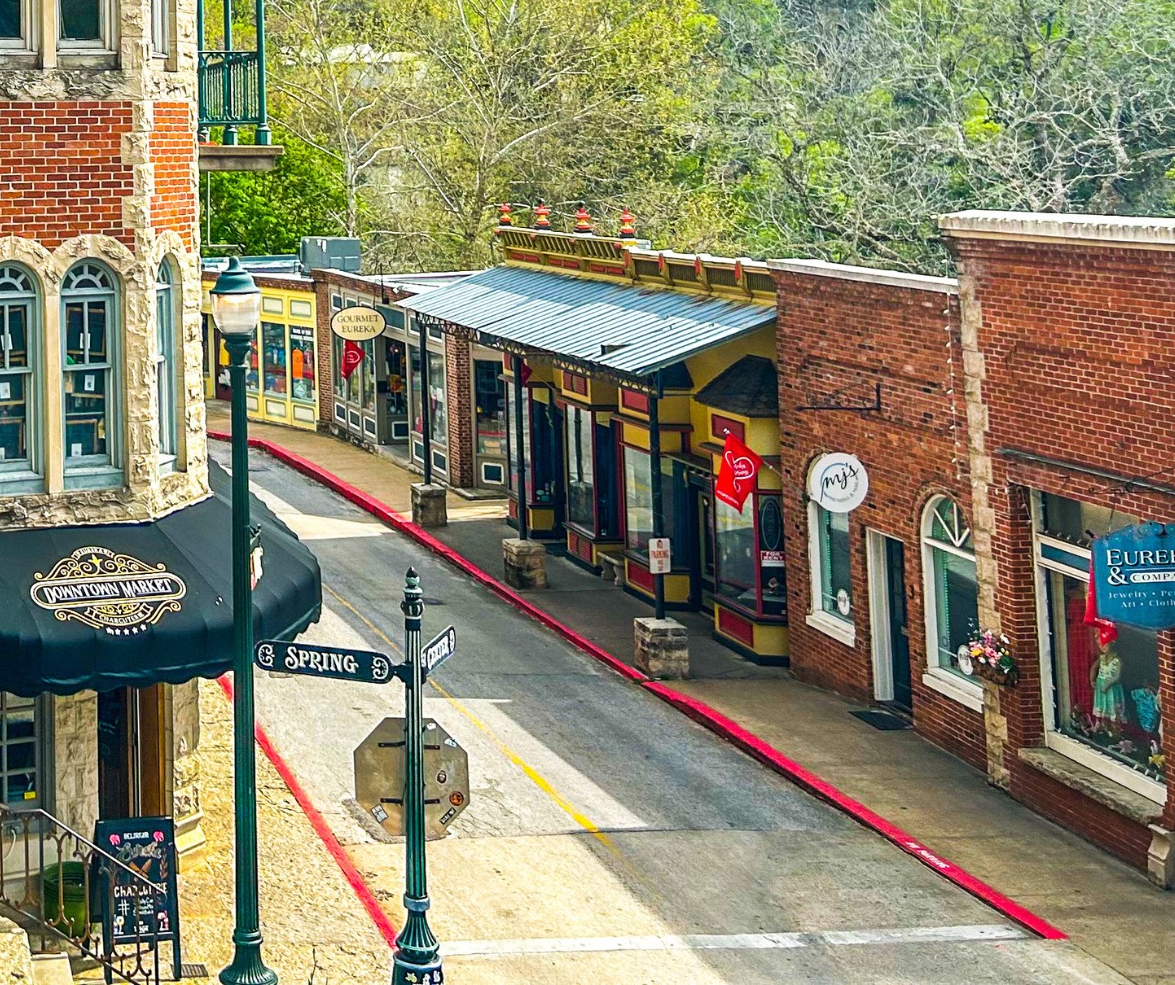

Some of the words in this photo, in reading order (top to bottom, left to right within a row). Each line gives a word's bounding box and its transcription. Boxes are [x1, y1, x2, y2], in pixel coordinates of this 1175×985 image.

[336, 314, 379, 324] GOURMET
[341, 324, 377, 333] EUREKA
[1107, 566, 1129, 586] &
[42, 581, 120, 604] DOWNTOWN
[120, 577, 173, 598] MARKET
[1108, 591, 1147, 600] Jewelry
[1121, 600, 1136, 608] Art
[284, 645, 359, 674] SPRING
